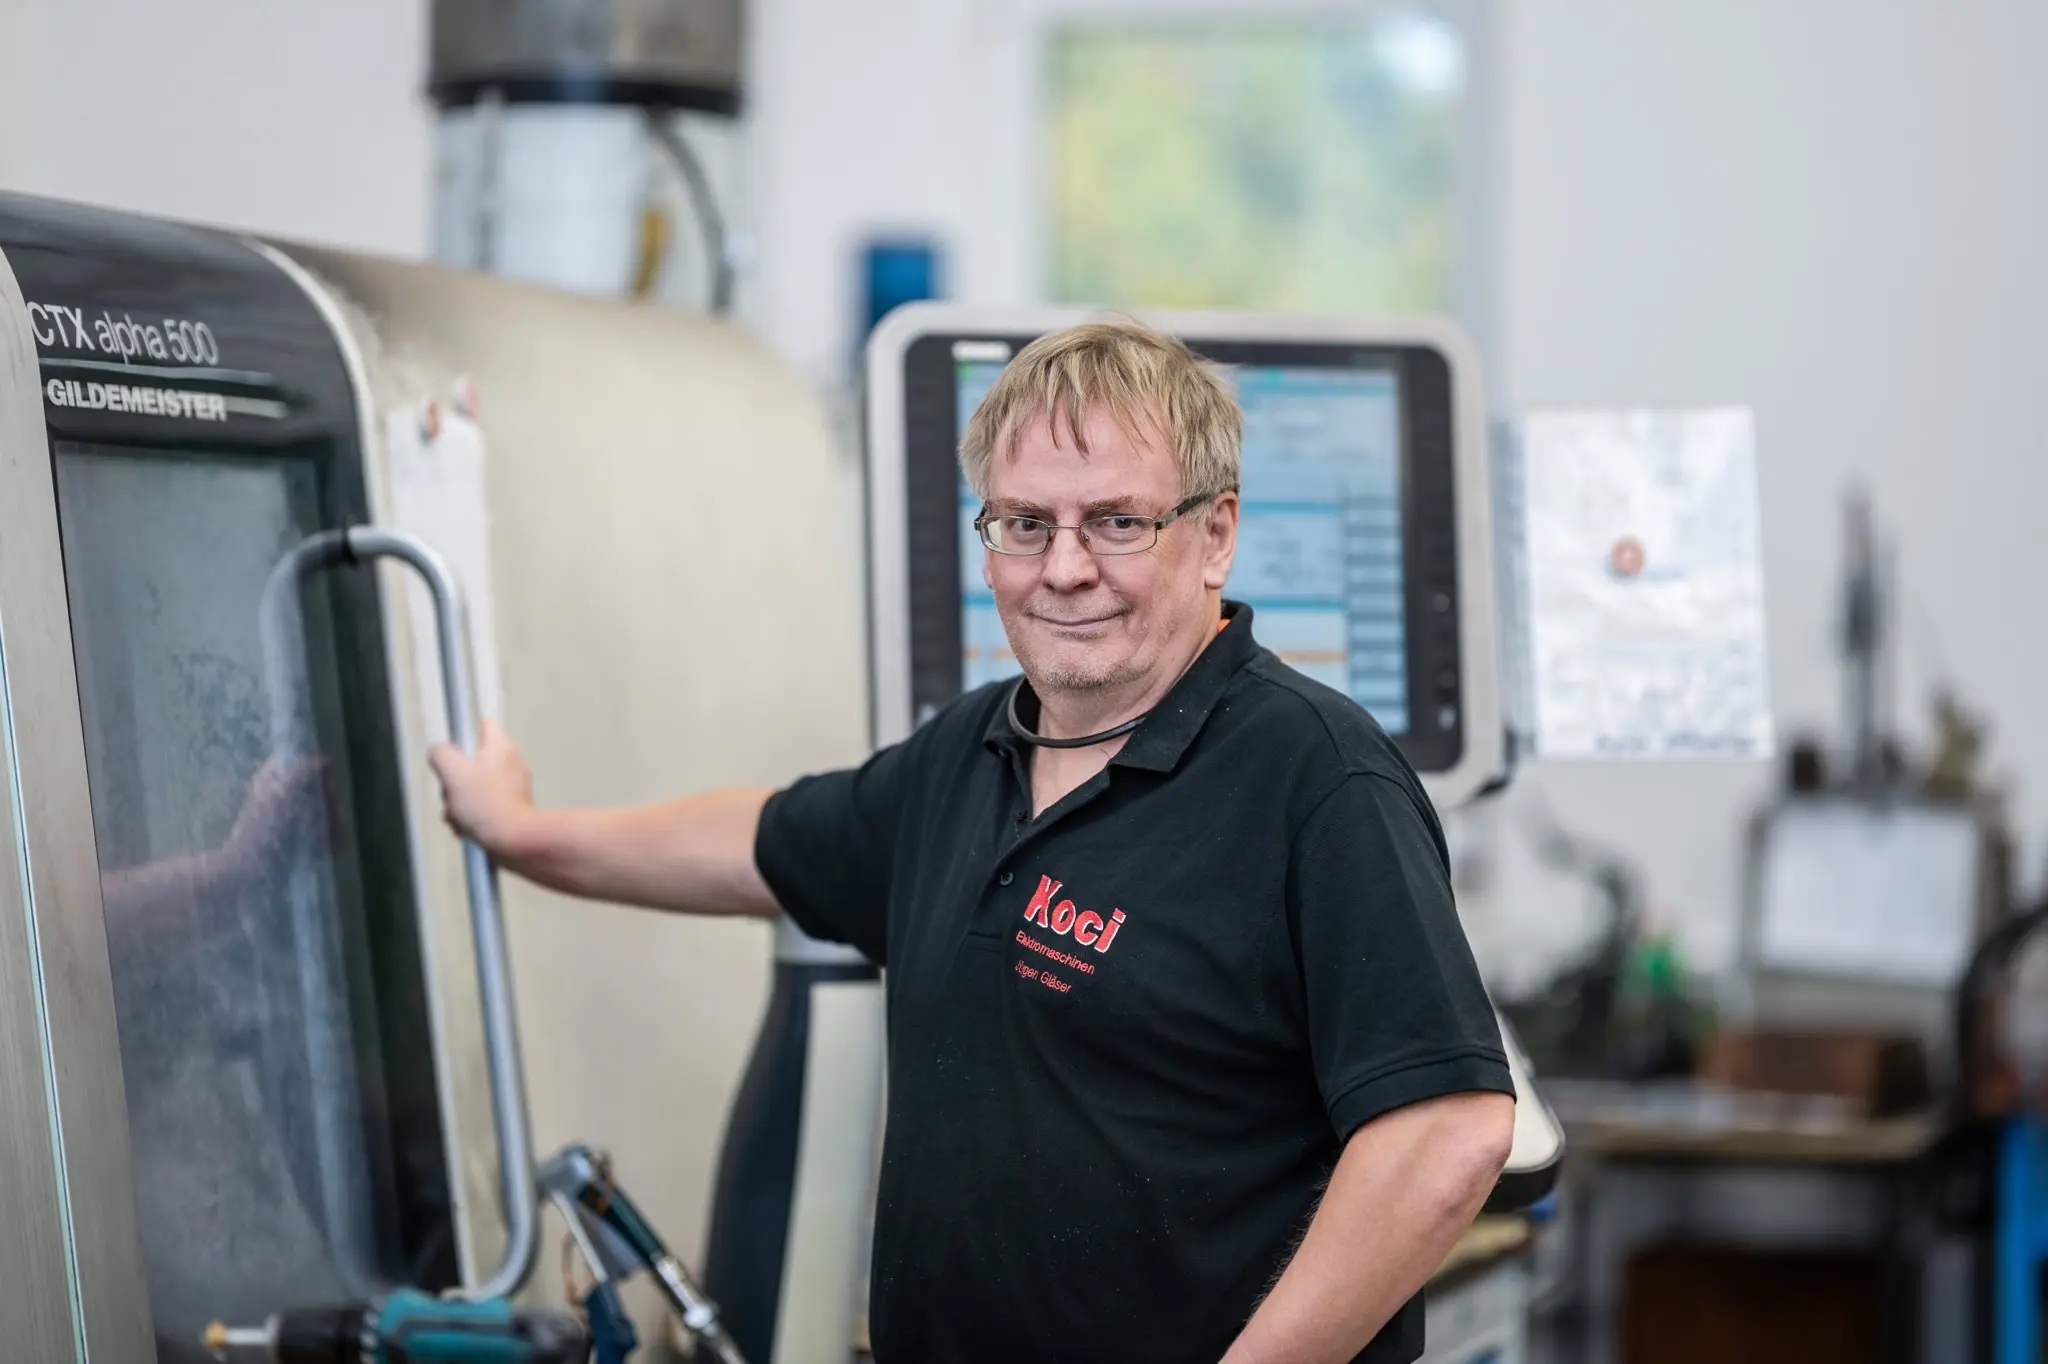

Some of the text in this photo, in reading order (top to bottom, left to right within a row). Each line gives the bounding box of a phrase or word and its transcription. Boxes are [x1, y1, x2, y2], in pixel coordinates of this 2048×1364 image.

[26, 301, 219, 366] CTX alpha 500
[47, 379, 227, 422] GILDEMEISTER
[1024, 874, 1126, 953] Koci
[1040, 971, 1072, 993] Gläser
